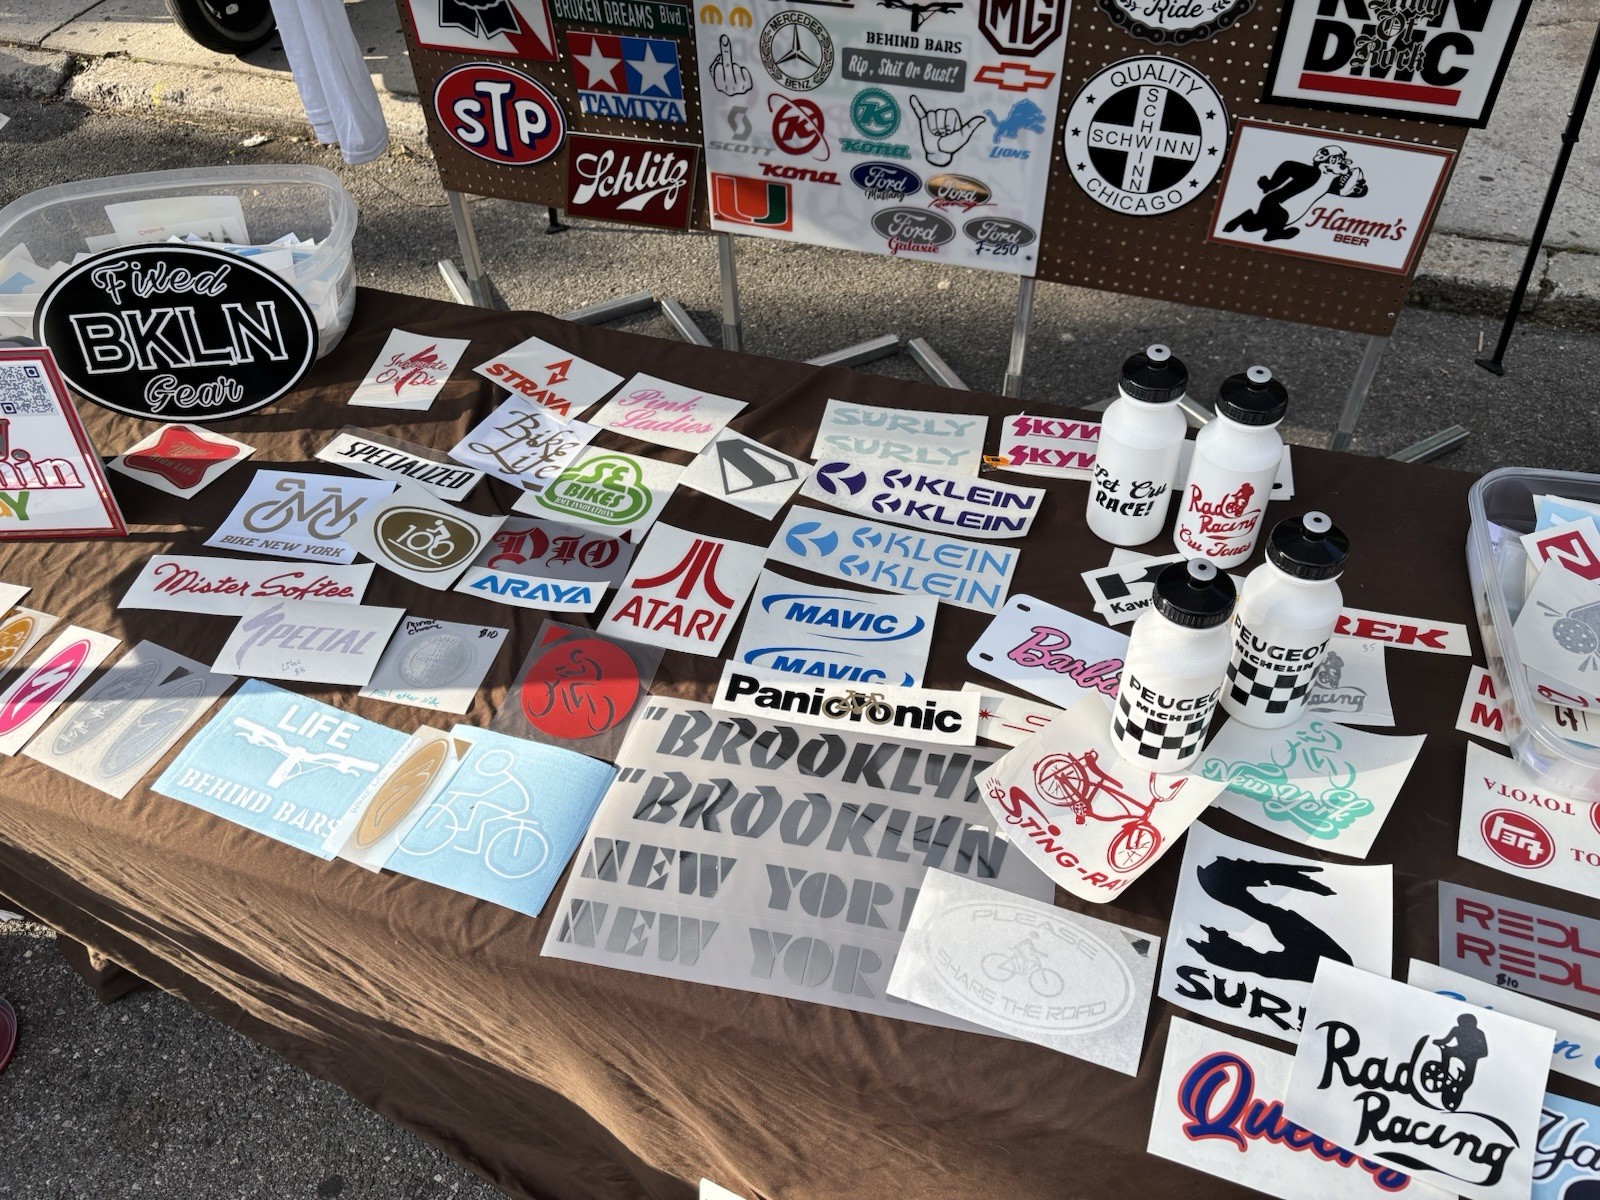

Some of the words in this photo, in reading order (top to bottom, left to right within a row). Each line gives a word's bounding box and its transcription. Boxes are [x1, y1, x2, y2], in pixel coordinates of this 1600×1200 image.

[555, 0, 602, 23] BROKEN
[603, 0, 655, 30] DREAMS
[659, 5, 686, 26] Blvd.
[769, 13, 823, 36] MERCEDES
[989, 0, 1055, 45] MG
[1143, 0, 1204, 24] Ride
[866, 31, 920, 49] BEHIND
[924, 38, 963, 54] BARS
[1350, 35, 1427, 72] Rock
[784, 78, 812, 90] BENZ
[878, 58, 905, 77] Shit
[905, 60, 921, 79] Or
[923, 65, 960, 84] Bust!
[1110, 63, 1203, 96] QUALITY
[452, 80, 549, 157] STP
[578, 91, 687, 124] TAMIYA
[707, 140, 777, 158] SCOTT
[1091, 128, 1195, 157] SCHWINN
[1129, 88, 1160, 192] SCHWINN
[572, 149, 689, 212] Schlitz
[864, 165, 908, 193] Ford
[864, 186, 907, 203] Mustang
[937, 175, 978, 203] Ford
[1086, 177, 1184, 212] CHICAGO
[887, 212, 939, 242] Ford
[976, 220, 1022, 244] Ford
[1305, 206, 1408, 241] Hamm's
[1332, 233, 1371, 248] BEER
[887, 235, 941, 256] Galaxie
[975, 240, 1020, 256] F-250
[91, 260, 232, 306] Fixed
[69, 300, 290, 375] BKLN
[144, 374, 244, 414] Gear
[408, 371, 438, 387] Die
[485, 363, 574, 418] STRAVA
[618, 389, 703, 413] Pink
[493, 410, 582, 455] Bike
[609, 408, 715, 436] Ladies
[830, 407, 977, 438] SURLY
[337, 441, 476, 491] SPECIALIZED
[467, 440, 564, 480] Life
[824, 434, 972, 467] SURLY
[562, 482, 626, 508] BIKES
[583, 462, 632, 494] SE
[914, 474, 1036, 510] KLEIN
[903, 500, 1027, 532] KLEIN
[1095, 490, 1155, 517] RACE!
[1199, 511, 1260, 540] Racing
[218, 534, 260, 549] BIKE
[259, 538, 301, 553] NEW
[304, 543, 349, 559] YORK
[487, 526, 620, 570] DIO
[883, 532, 1012, 578] KLEIN
[154, 562, 251, 597] Mister
[251, 571, 355, 601] Softee
[470, 574, 592, 605] ARAYA
[870, 560, 1003, 610] KLEIN
[478, 628, 499, 639] $10
[611, 594, 728, 643] ATARI
[783, 602, 901, 635] MAVIC
[235, 601, 379, 671] SPECIAL
[1234, 612, 1332, 662] PEUGEOT
[1235, 639, 1315, 673] MICHELIN
[1135, 700, 1216, 723] MICHELI
[1307, 692, 1367, 712] acing
[276, 703, 361, 750] LIFE
[177, 766, 274, 815] BEHIND
[272, 800, 344, 841] BARS
[1262, 782, 1375, 841] York
[1483, 776, 1577, 816] TOYOTA
[987, 784, 1136, 891] STING-RAY
[580, 836, 738, 899] NEW
[765, 863, 919, 934] YOR
[556, 898, 720, 967] NEW
[749, 927, 898, 1001] YOR
[971, 907, 1099, 961] PLEASE
[936, 949, 997, 1006] SHARE
[999, 996, 1045, 1020] THE
[1045, 1000, 1108, 1021] ROAD
[1174, 965, 1307, 1033] SUR
[1315, 1020, 1436, 1106] Rad
[1353, 1090, 1516, 1187] Racing
